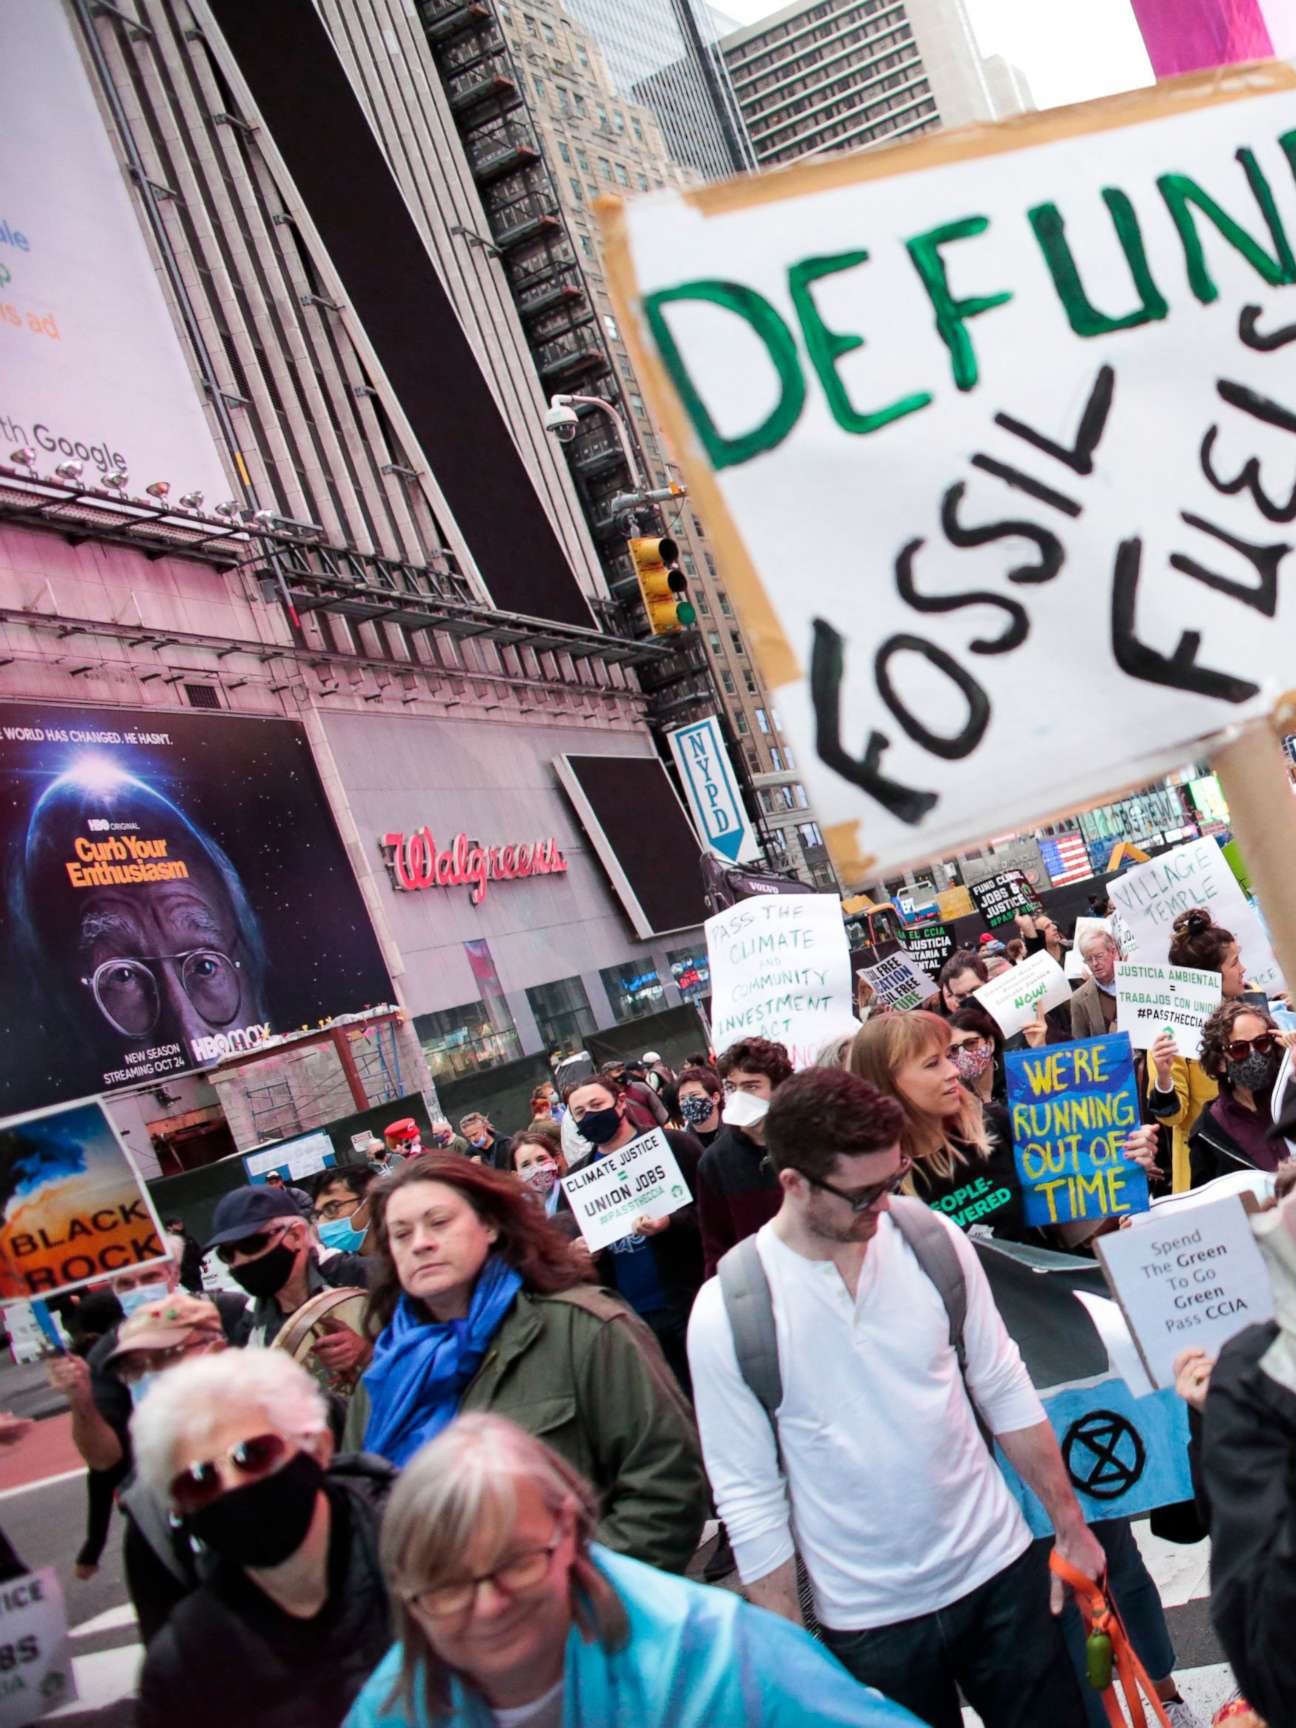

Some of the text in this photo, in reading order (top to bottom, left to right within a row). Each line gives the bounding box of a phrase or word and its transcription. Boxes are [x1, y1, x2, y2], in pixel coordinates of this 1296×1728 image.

[26, 311, 61, 341] ad
[33, 423, 128, 473] Google
[810, 362, 1116, 826] FOSSIL
[3, 727, 45, 742] WORLD
[45, 729, 69, 743] HAS
[70, 730, 125, 745] CHANGED.
[125, 732, 138, 744] HE
[688, 732, 730, 833] NYPD
[88, 819, 110, 831] HBO
[74, 835, 168, 863] Curb Your
[66, 859, 190, 888] Enthusiasm
[383, 825, 568, 904] Walgreens
[1114, 848, 1213, 911] VILLAGE
[749, 881, 780, 895] VOLVO
[981, 887, 1009, 908] JOBS
[1144, 876, 1219, 926] TEMPLE
[986, 894, 1027, 919] JUSTICE
[712, 904, 805, 943] PASS THE
[924, 926, 945, 938] CCIA
[729, 929, 816, 965] CLIMATE
[909, 935, 952, 951] JUSTICIA
[877, 956, 902, 977] FREE
[1117, 965, 1220, 988] JUSTICIA AMBIENTAL
[732, 969, 830, 1003] COMMUNITY
[894, 976, 921, 997] FREE
[1014, 983, 1048, 1010] NOW!
[1119, 991, 1171, 1006] TRABAJOS
[1174, 996, 1191, 1010] CON
[719, 994, 833, 1035] INVESTMENT
[759, 1018, 793, 1040] ACT
[124, 1043, 182, 1065] NEW SEASON
[103, 1056, 186, 1085] STREAMING OCT 24
[1023, 1045, 1109, 1097] WE'RE
[1013, 1091, 1136, 1142] RUNNING
[566, 1135, 660, 1193] CLIMATE JUSTICE
[1022, 1130, 1127, 1180] OUT OF
[584, 1165, 666, 1217] UNION JOBS
[1034, 1167, 1132, 1223] TIME
[10, 1199, 149, 1258] BLACK
[1151, 1229, 1202, 1257] Spend
[23, 1234, 167, 1294] ROCK
[1142, 1244, 1228, 1280] The Green
[1168, 1268, 1216, 1291] To Go
[1174, 1286, 1225, 1309] Green
[1165, 1298, 1248, 1333] Pass CCIA
